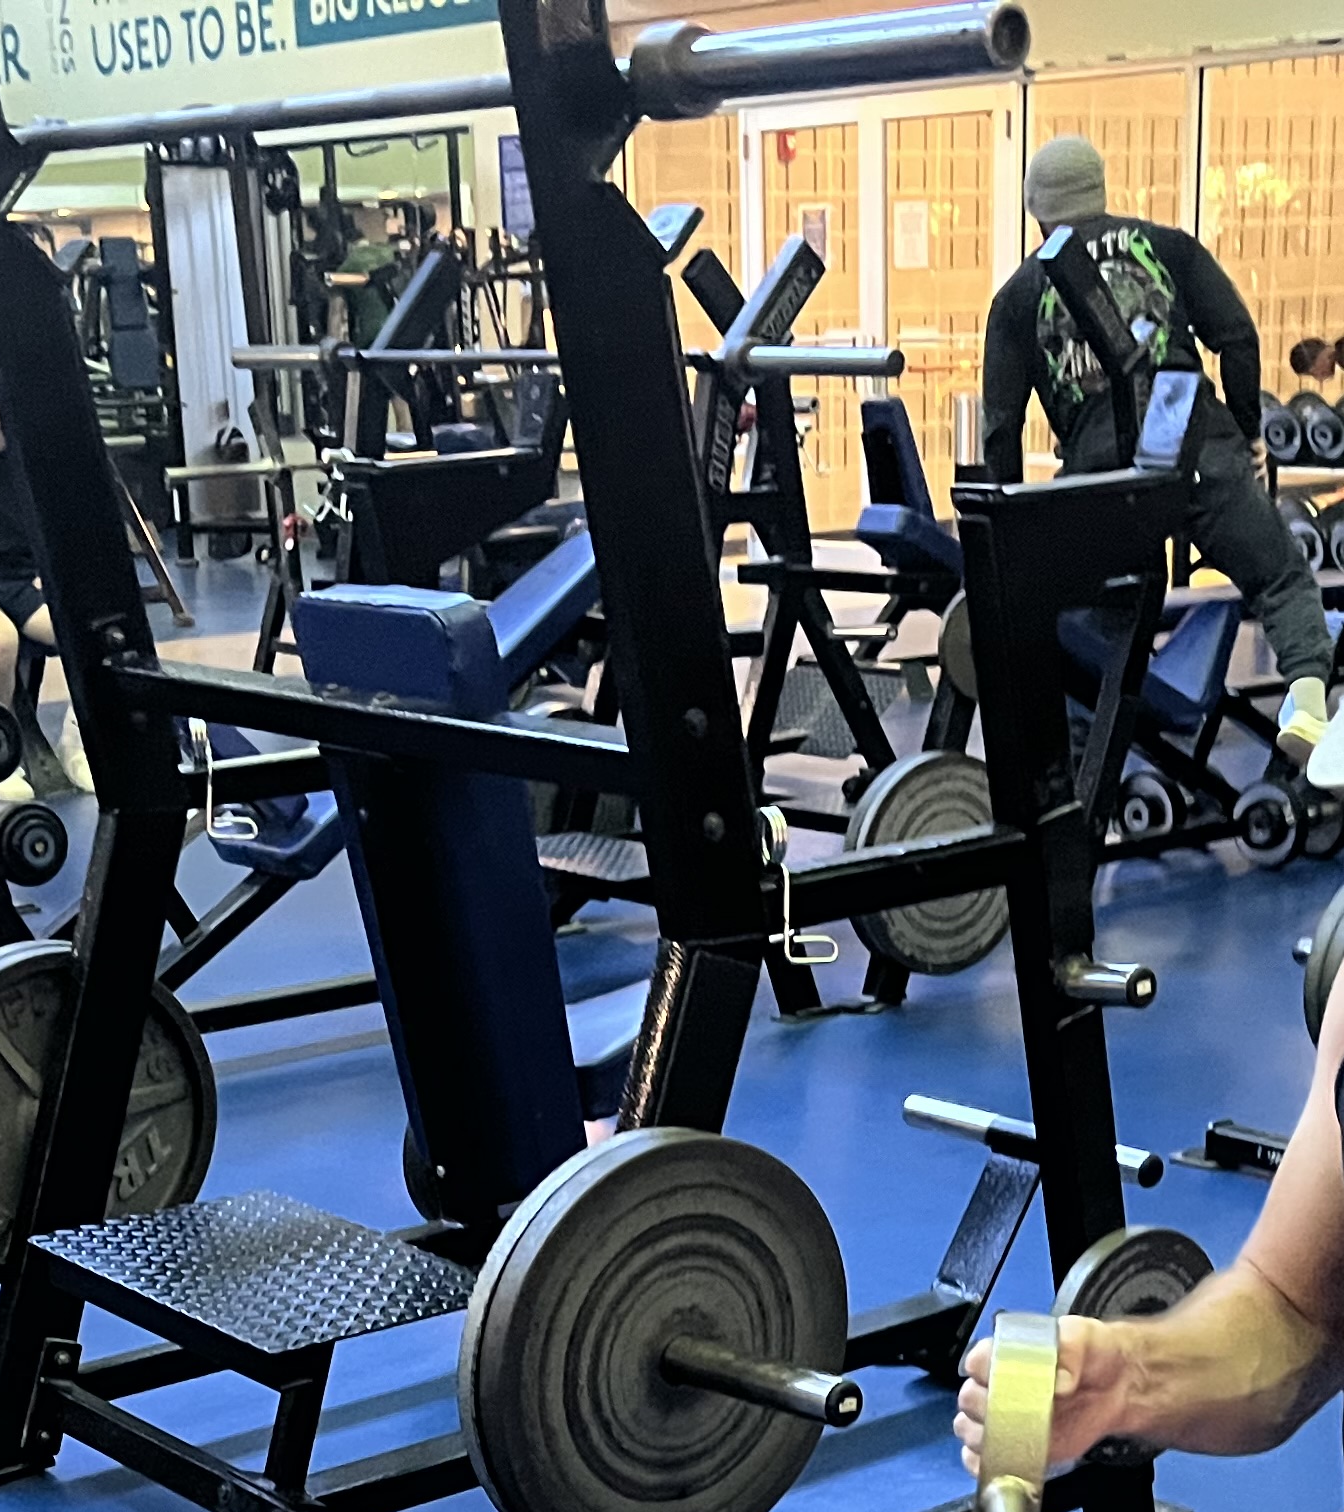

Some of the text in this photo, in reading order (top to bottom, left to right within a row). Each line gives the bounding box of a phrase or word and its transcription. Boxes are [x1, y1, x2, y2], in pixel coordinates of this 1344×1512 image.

[90, 14, 172, 77] USED
[180, 5, 225, 64] TO
[235, 0, 287, 57] BE.
